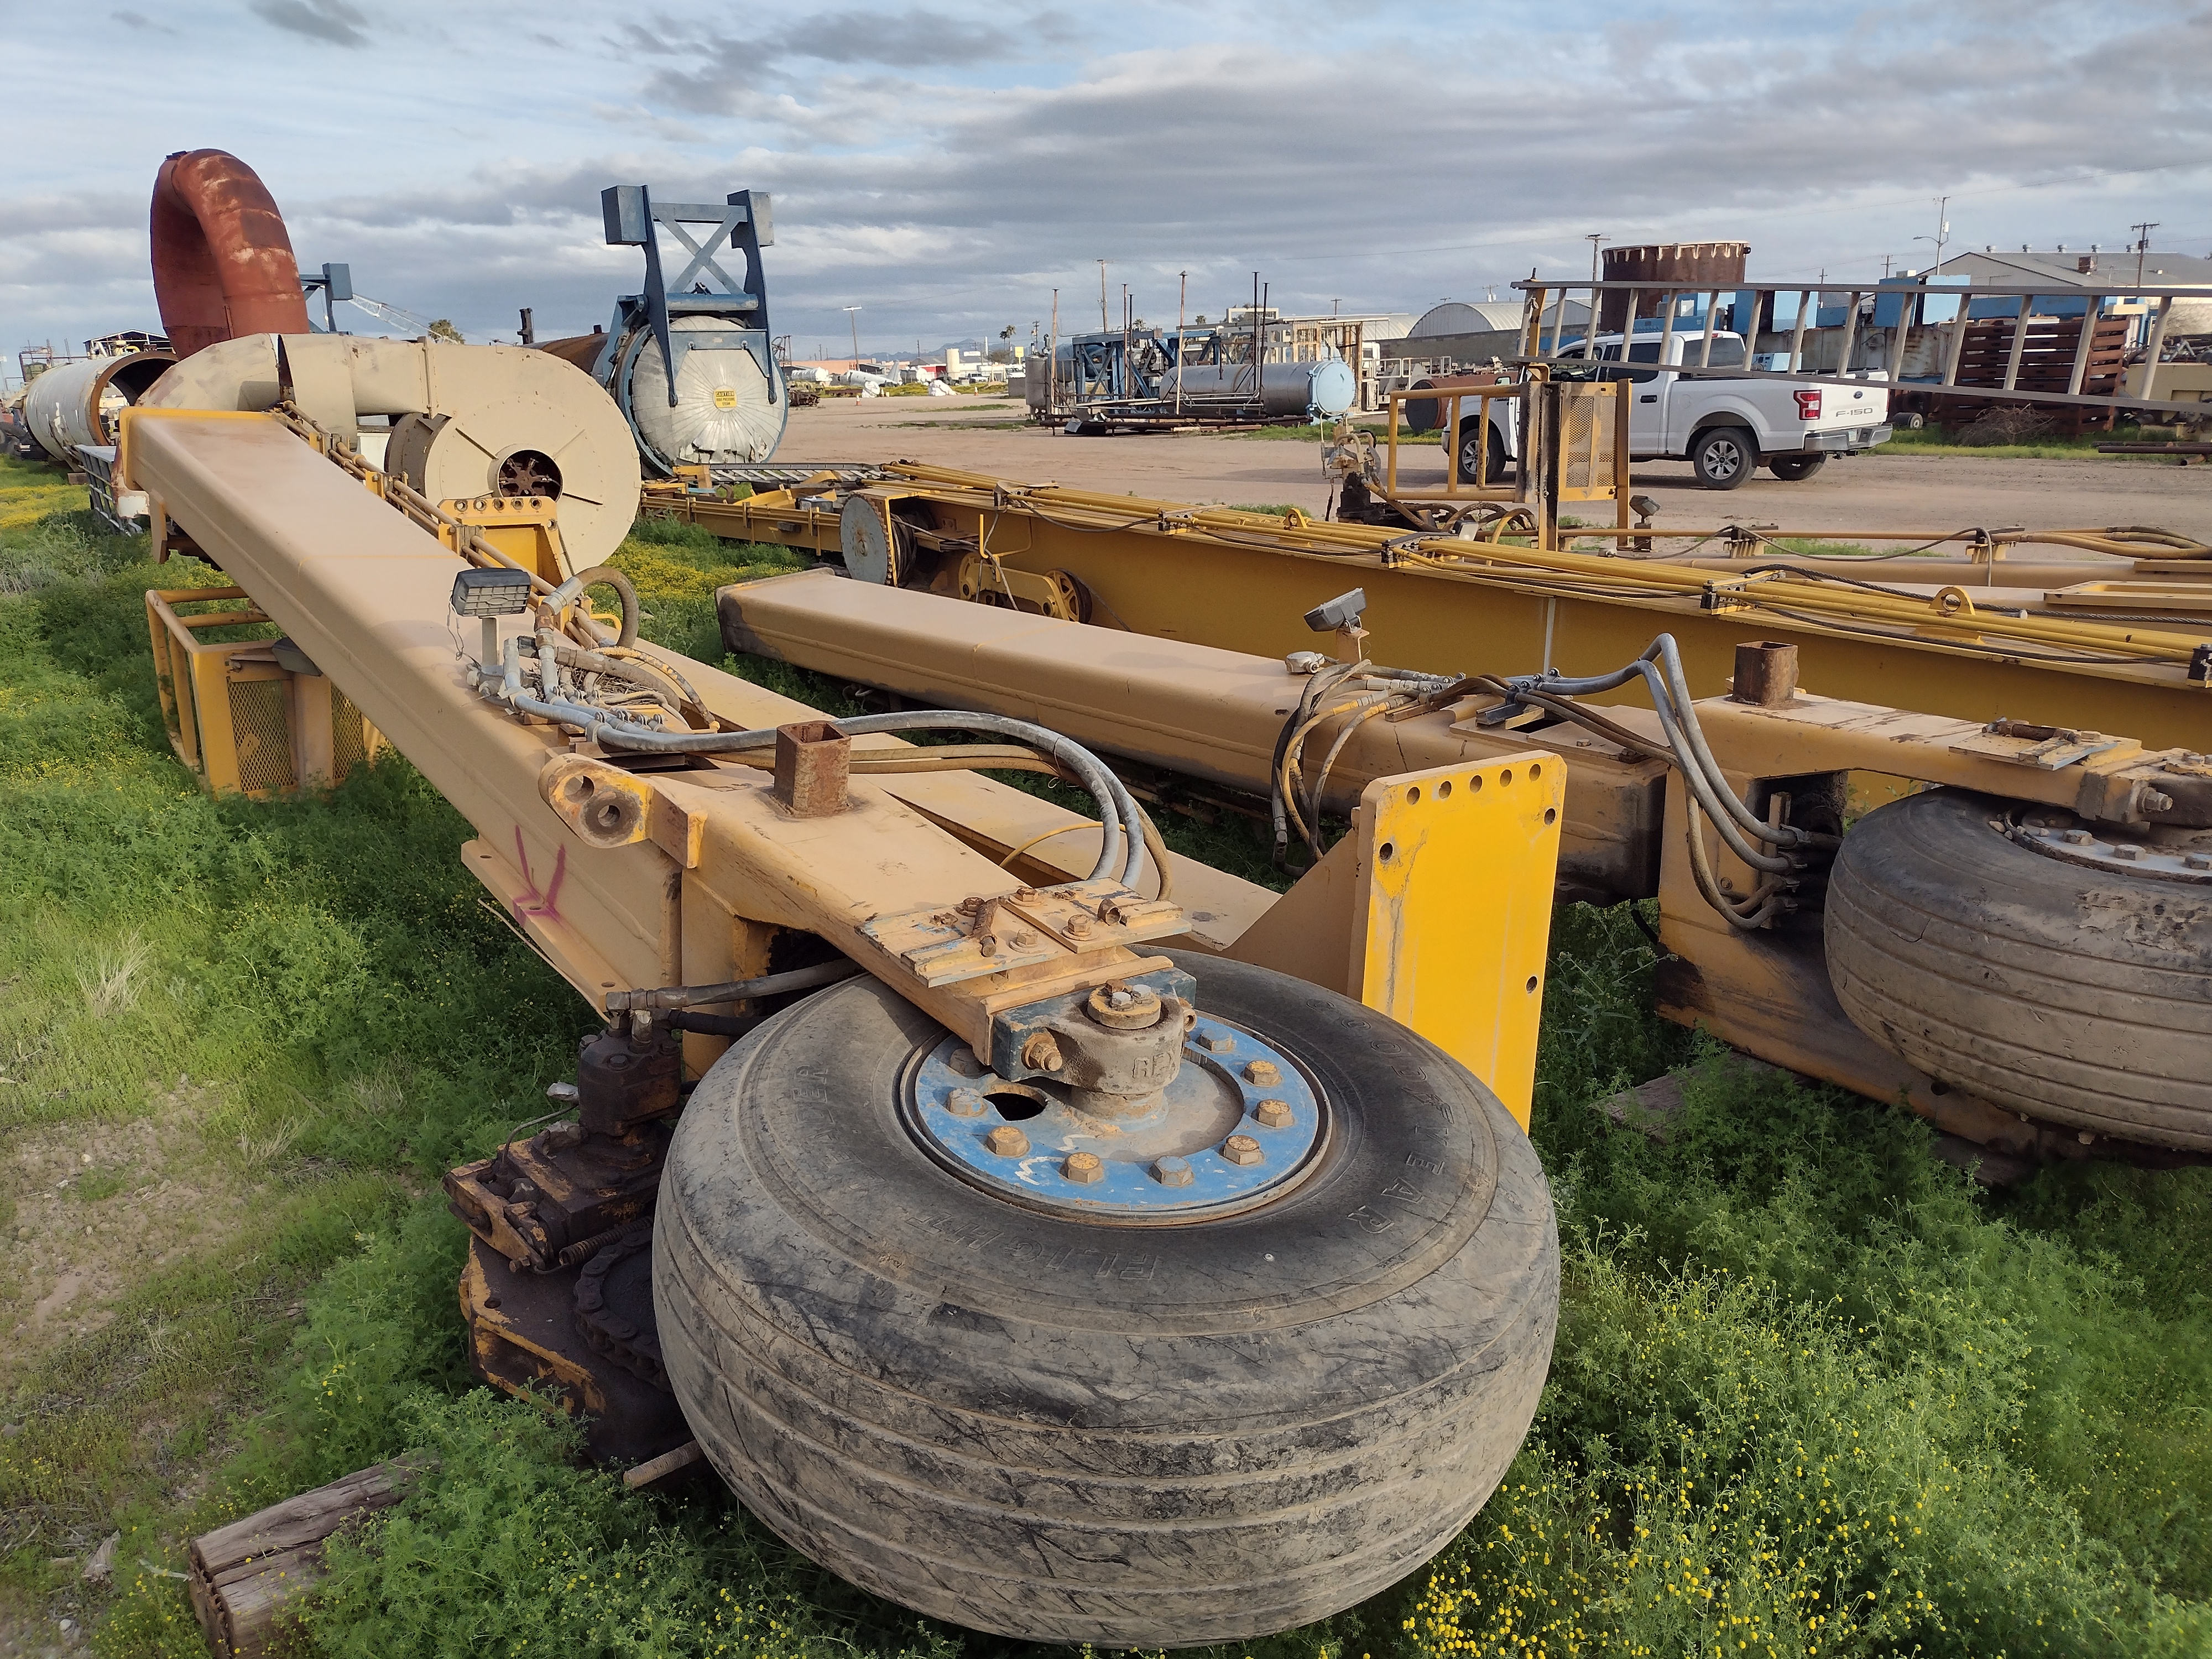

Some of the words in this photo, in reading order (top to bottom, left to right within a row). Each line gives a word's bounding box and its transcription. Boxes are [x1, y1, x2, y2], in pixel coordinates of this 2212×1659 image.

[1835, 408, 1873, 418] F-150
[1306, 998, 1454, 1233] GOODYEAR
[904, 1211, 1158, 1280] FLIGHT
